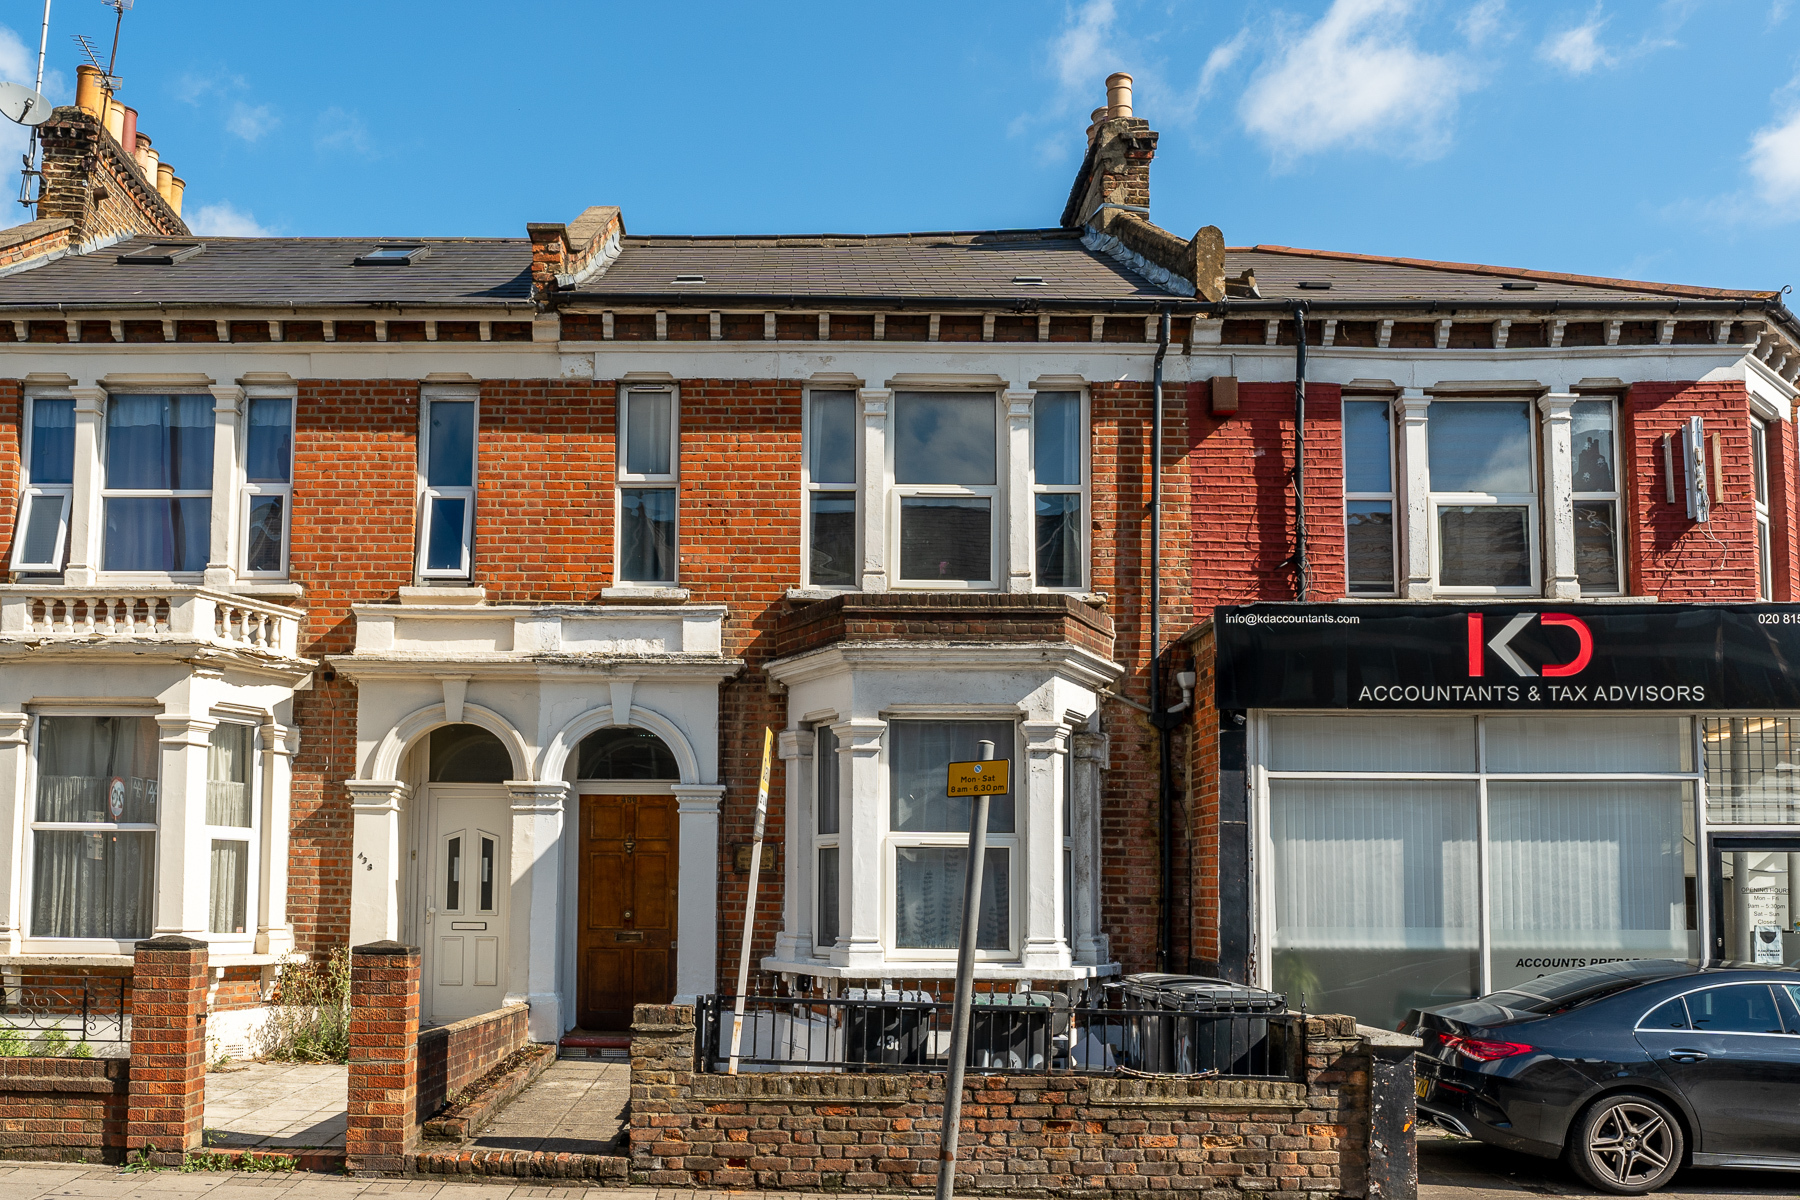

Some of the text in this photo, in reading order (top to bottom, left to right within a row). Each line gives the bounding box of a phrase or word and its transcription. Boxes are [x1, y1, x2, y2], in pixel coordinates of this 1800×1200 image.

[1225, 613, 1360, 626] info@kdaccountants.com
[1758, 613, 1780, 624] 020
[1468, 612, 1594, 677] KD
[1358, 685, 1705, 702] ACCOUNTANTS & TAX ADVISORS
[973, 784, 992, 792] 6.30
[993, 784, 1004, 792] pm
[1516, 958, 1586, 968] ACCOUNTS
